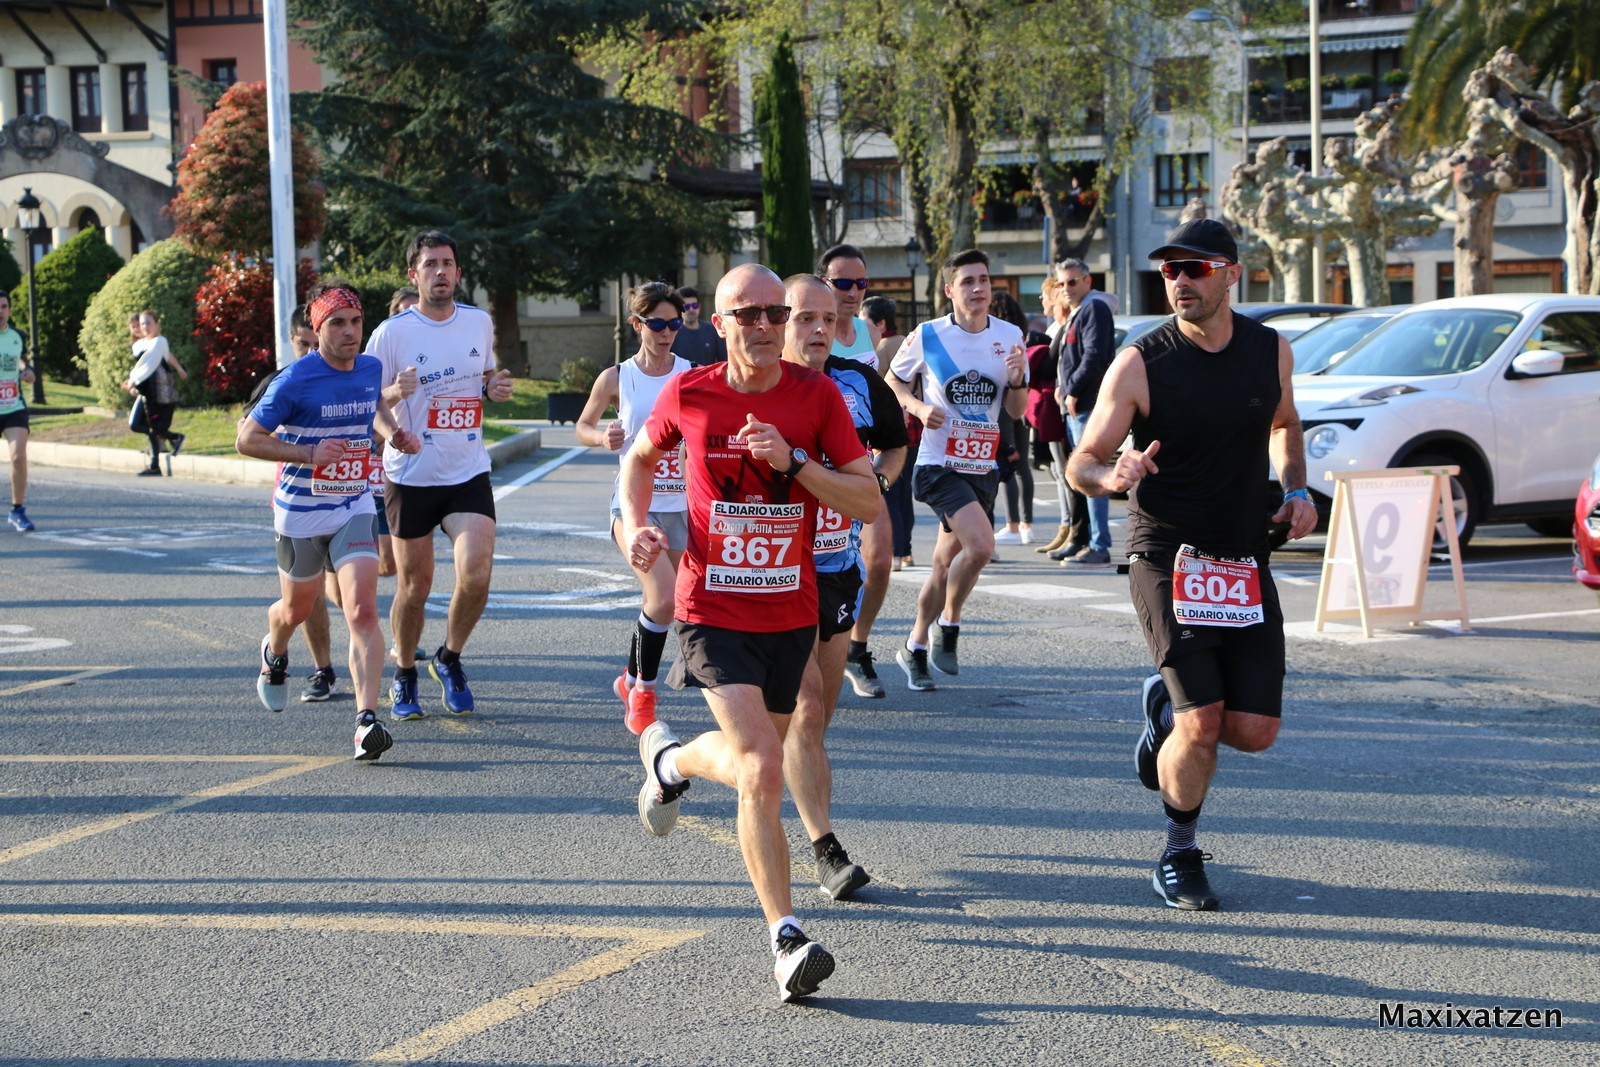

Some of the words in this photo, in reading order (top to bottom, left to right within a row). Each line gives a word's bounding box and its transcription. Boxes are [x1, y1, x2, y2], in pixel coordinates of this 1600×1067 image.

[420, 371, 441, 385] BSS
[443, 367, 455, 376] 48
[950, 381, 994, 393] Estrella
[953, 392, 992, 405] Galicia
[436, 409, 476, 428] 868
[961, 421, 982, 429] DIARIO
[954, 439, 993, 459] 938
[320, 460, 363, 480] 438
[953, 461, 975, 469] DIARIO
[714, 503, 726, 514] EL
[728, 505, 767, 515] DIARIO
[769, 505, 802, 516] VASCO
[822, 536, 847, 548] VASCO
[721, 536, 793, 566] 867
[710, 573, 723, 584] EL
[724, 574, 763, 586] DIARIO
[764, 574, 796, 586] VASCO
[1184, 573, 1249, 605] 604
[1176, 608, 1187, 617] EL
[1189, 609, 1224, 620] DIARIO
[1225, 611, 1259, 621] VASCO
